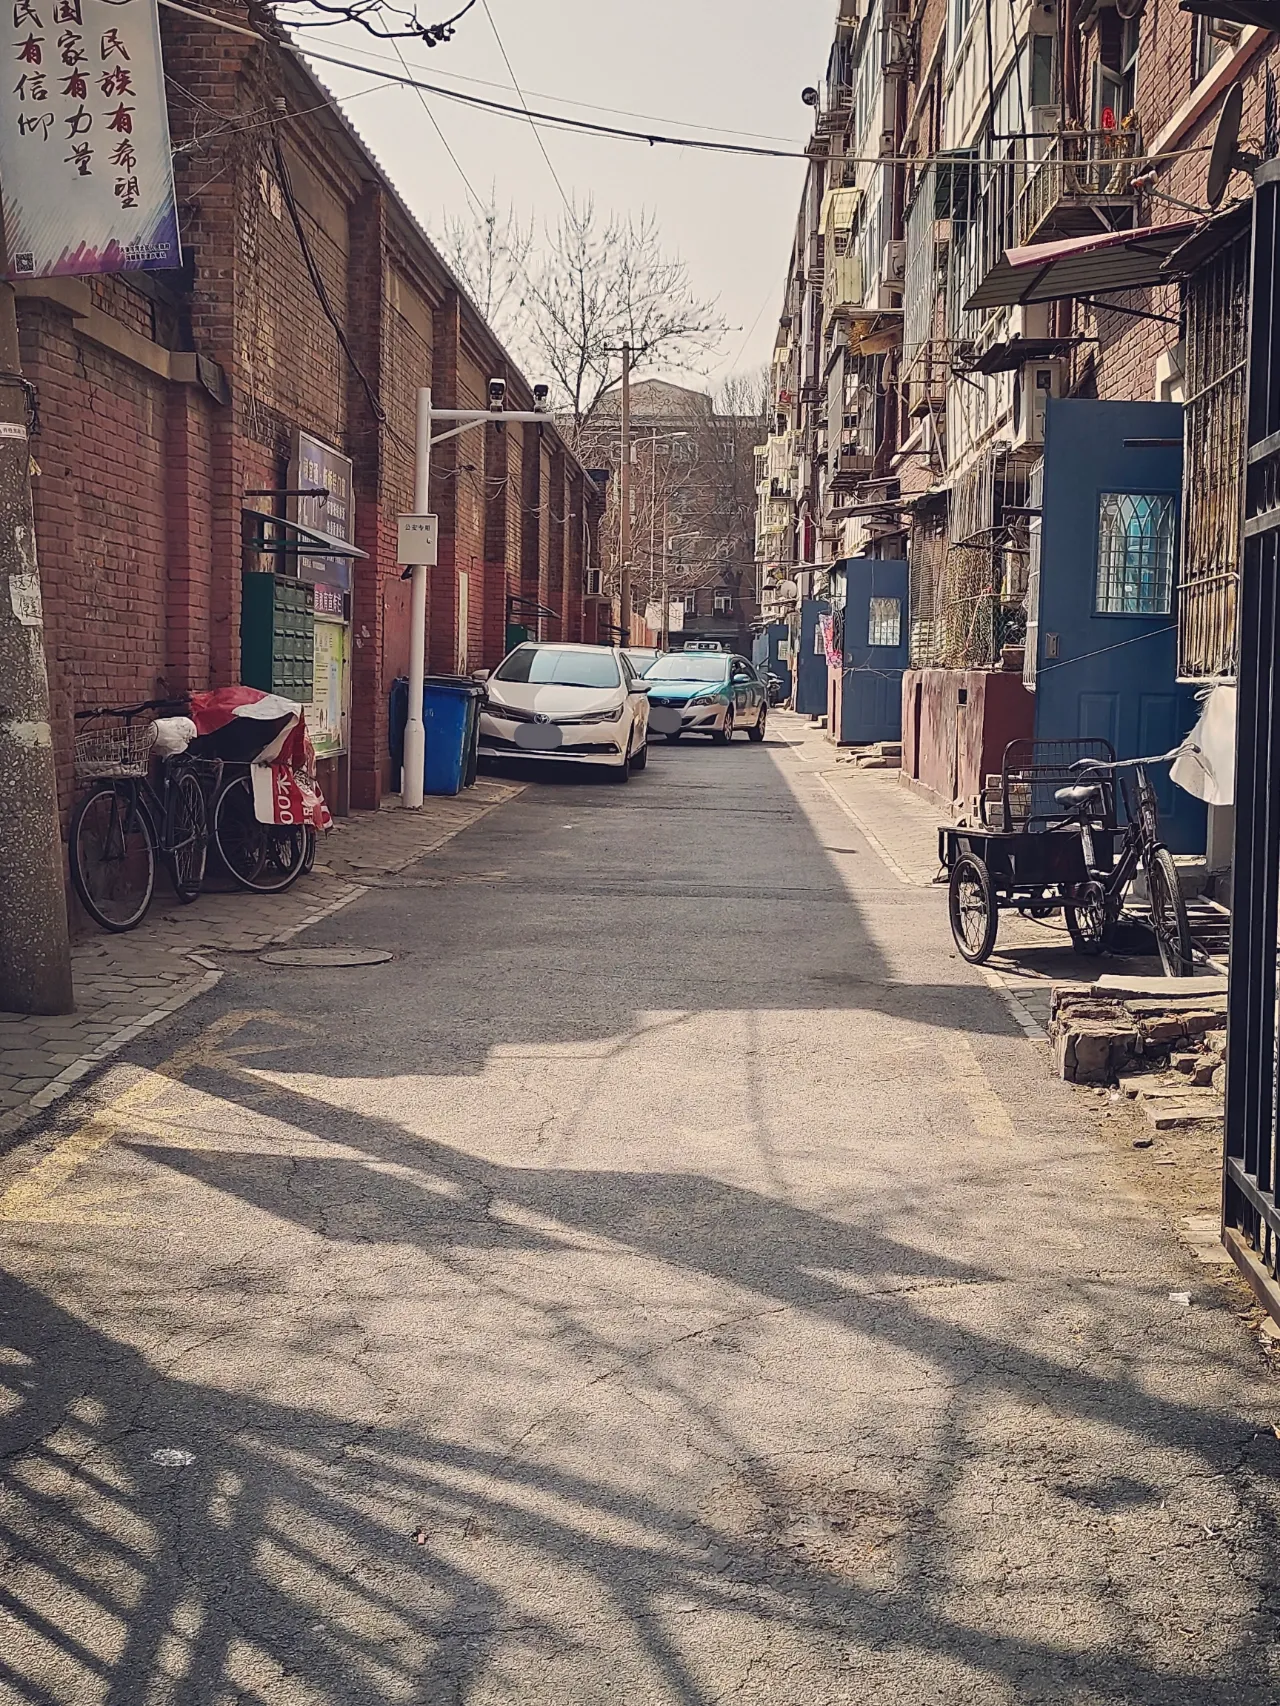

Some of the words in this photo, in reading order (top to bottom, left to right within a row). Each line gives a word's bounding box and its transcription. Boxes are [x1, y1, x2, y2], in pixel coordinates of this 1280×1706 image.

[12, 0, 55, 142] 民有信仰
[52, 0, 95, 176] 国家有力量
[94, 28, 141, 210] 民族有希望
[404, 523, 431, 532] 公安专用
